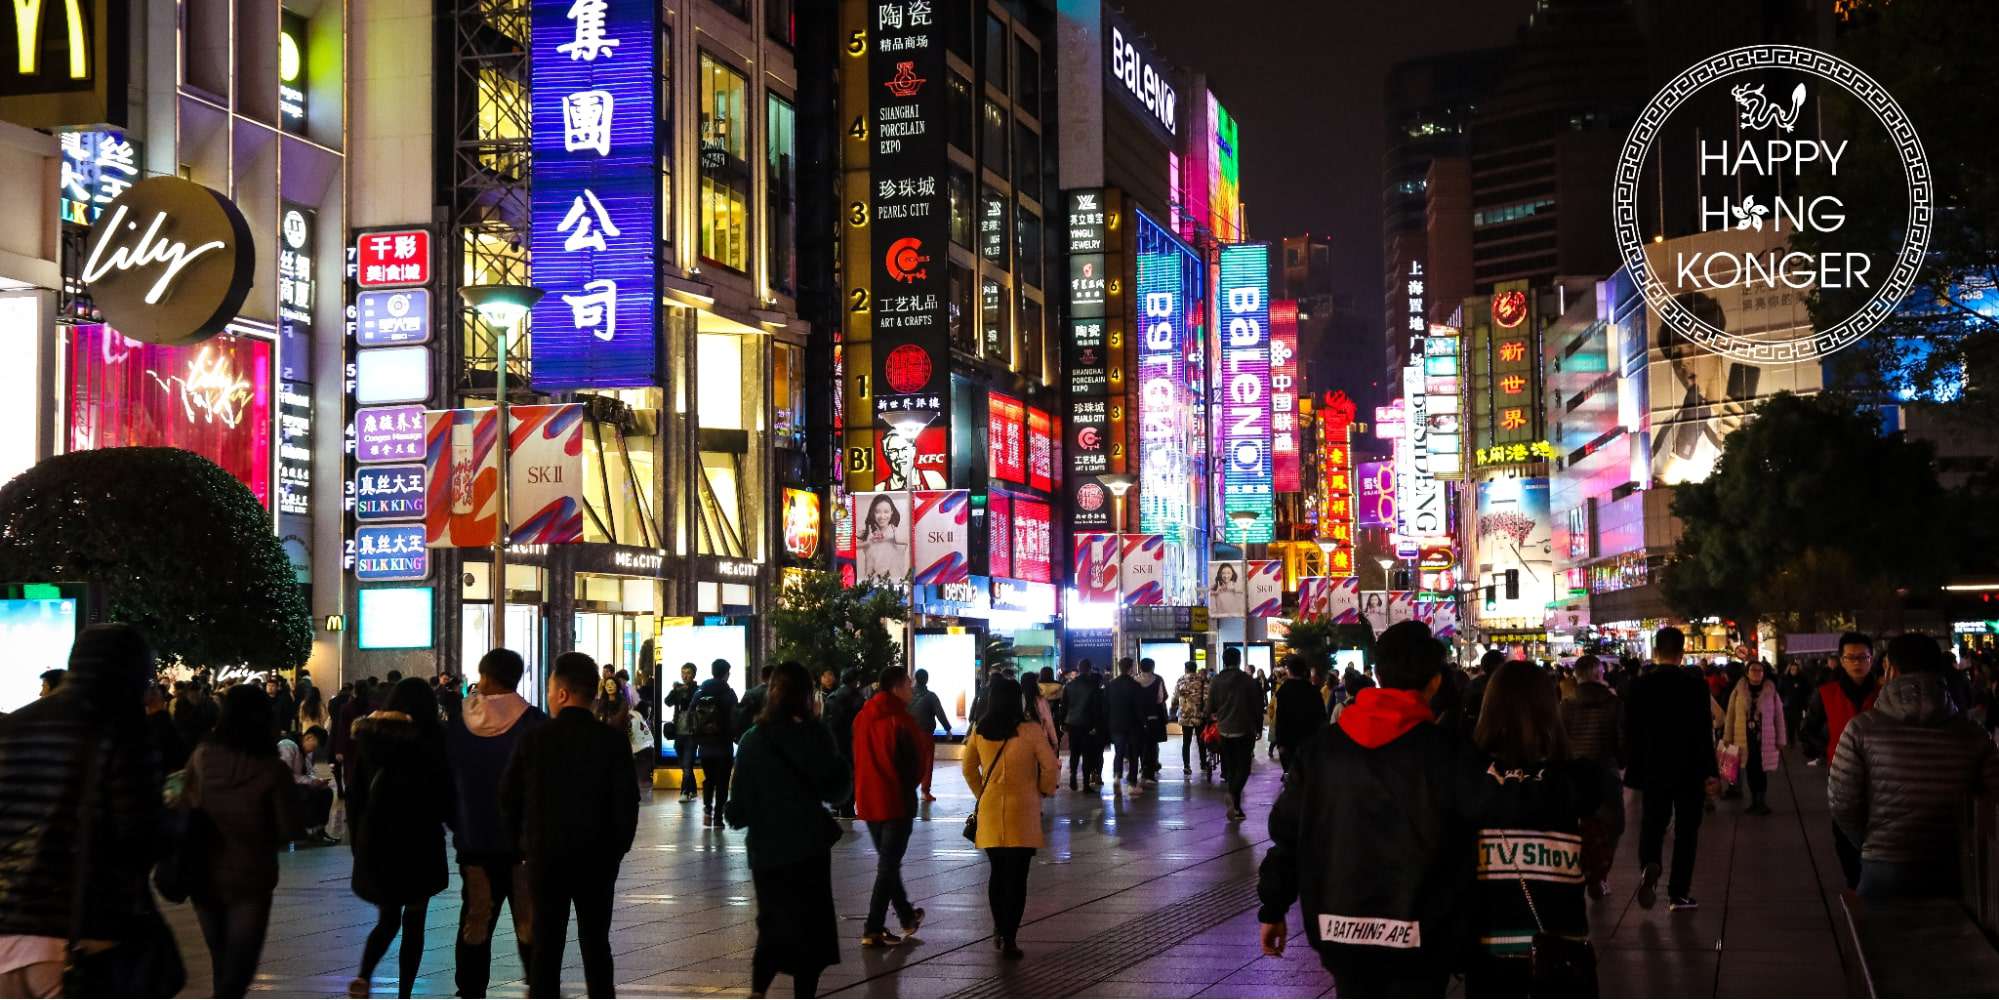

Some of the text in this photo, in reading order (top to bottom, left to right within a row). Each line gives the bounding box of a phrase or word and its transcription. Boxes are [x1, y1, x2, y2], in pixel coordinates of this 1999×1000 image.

[878, 0, 933, 31] 陶瓷
[848, 29, 867, 57] 5
[880, 34, 929, 52] 精品商场
[880, 104, 920, 121] SHANGHAI
[848, 114, 869, 141] 4
[880, 120, 926, 138] PORCELAIN
[880, 139, 901, 154] EXPO
[878, 176, 936, 199] 珍珠城
[849, 201, 869, 227] 3
[878, 203, 930, 219] PEARLS CITY
[1109, 212, 1119, 230] 7
[1070, 239, 1101, 250] JEWELRY
[1110, 279, 1120, 296] 6
[849, 287, 870, 313] 2
[880, 294, 938, 313] 工艺礼品
[880, 314, 933, 328] ART & CRAFTS
[1075, 323, 1101, 338] 陶瓷
[1111, 331, 1120, 347] 5
[1072, 368, 1104, 376] SHANGHAI
[1111, 367, 1120, 382] 4
[856, 374, 869, 400] 1
[1072, 376, 1106, 385] PORCELAIN
[1072, 384, 1089, 392] EXPO
[1499, 341, 1528, 431] 新世界
[1074, 402, 1105, 414] 珍珠城
[1112, 406, 1120, 420] 3
[1272, 373, 1293, 452] 中国联通
[1093, 414, 1105, 423] CITY
[1112, 443, 1121, 458] 2
[850, 447, 874, 473] B1
[917, 453, 946, 465] KFC
[1074, 454, 1106, 464] 工艺礼品
[359, 475, 424, 496] 真丝大王
[359, 497, 424, 513] SILK KING
[359, 534, 425, 555] 真丝大王
[359, 556, 424, 572] SILK KING
[616, 553, 663, 569] ME&CITY
[719, 561, 758, 577] ME&CITY
[1326, 920, 1413, 944] A BATHING APE
